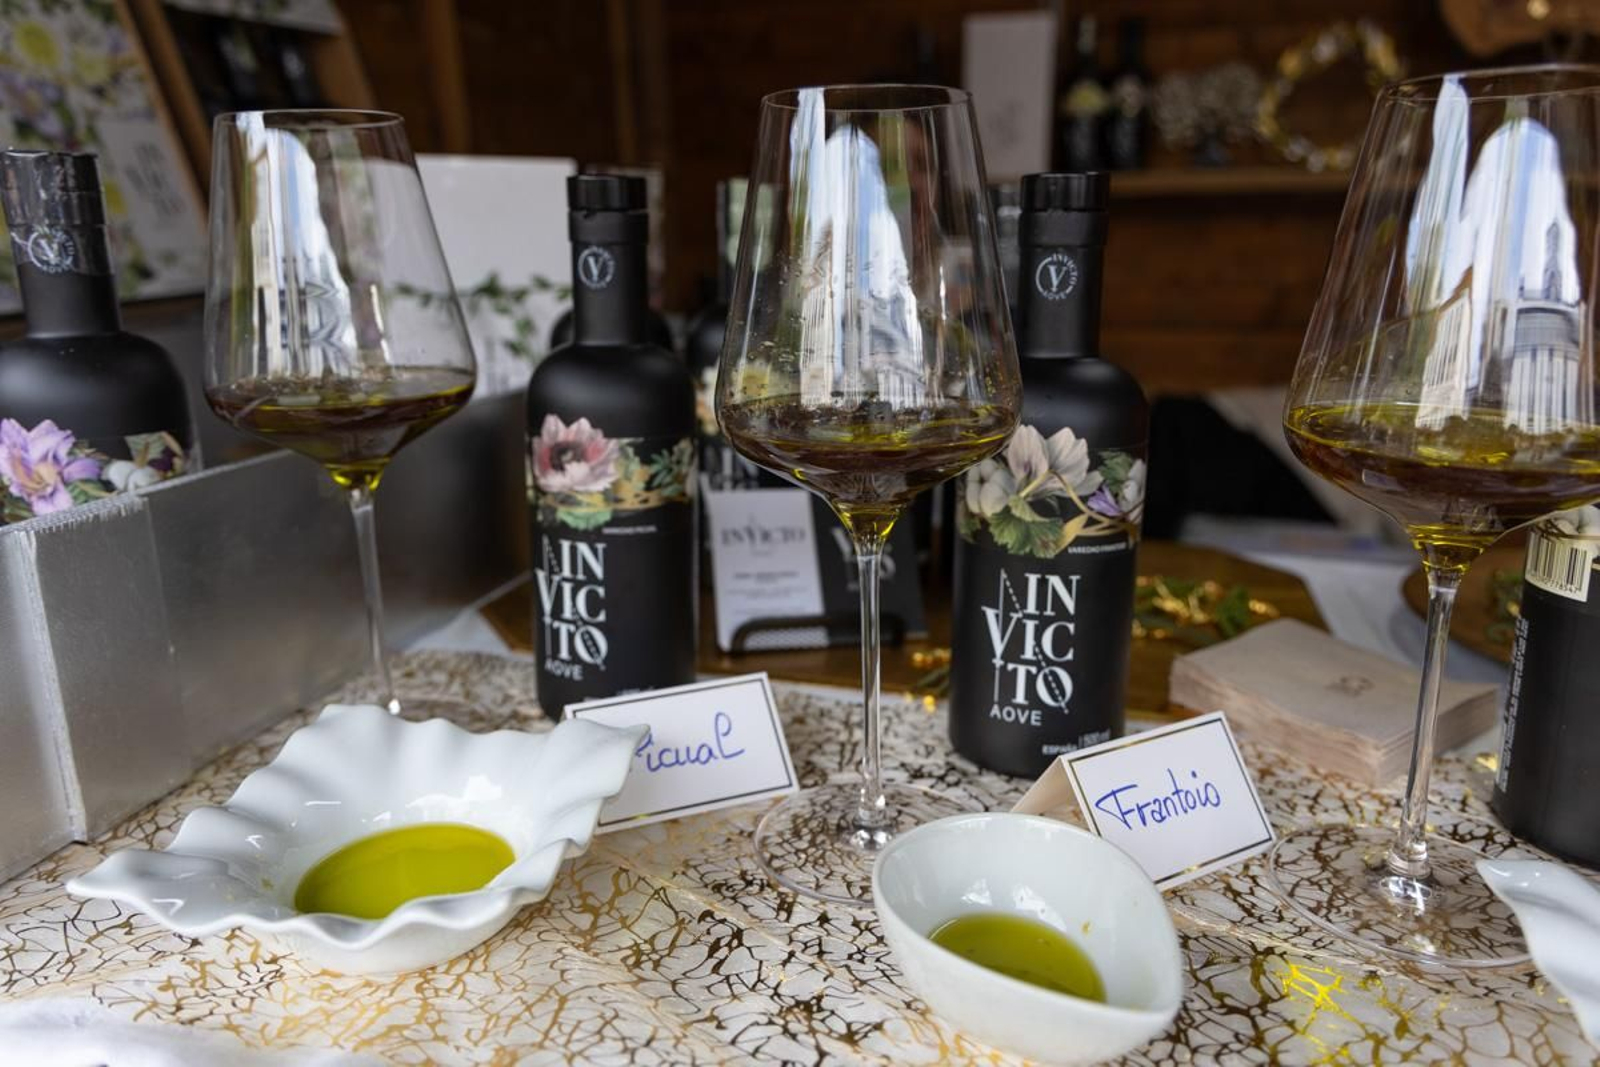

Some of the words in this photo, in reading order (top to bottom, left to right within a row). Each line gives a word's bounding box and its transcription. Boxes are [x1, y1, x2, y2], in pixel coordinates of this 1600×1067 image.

[559, 538, 608, 581] IN
[534, 567, 607, 625] VIC
[1022, 572, 1081, 616] IN
[980, 605, 1076, 666] VIC
[544, 658, 584, 681] AOVE
[1006, 661, 1075, 709] TO
[989, 702, 1043, 727] AOVE
[634, 711, 746, 773] icual
[1094, 767, 1221, 831] Frantoio
